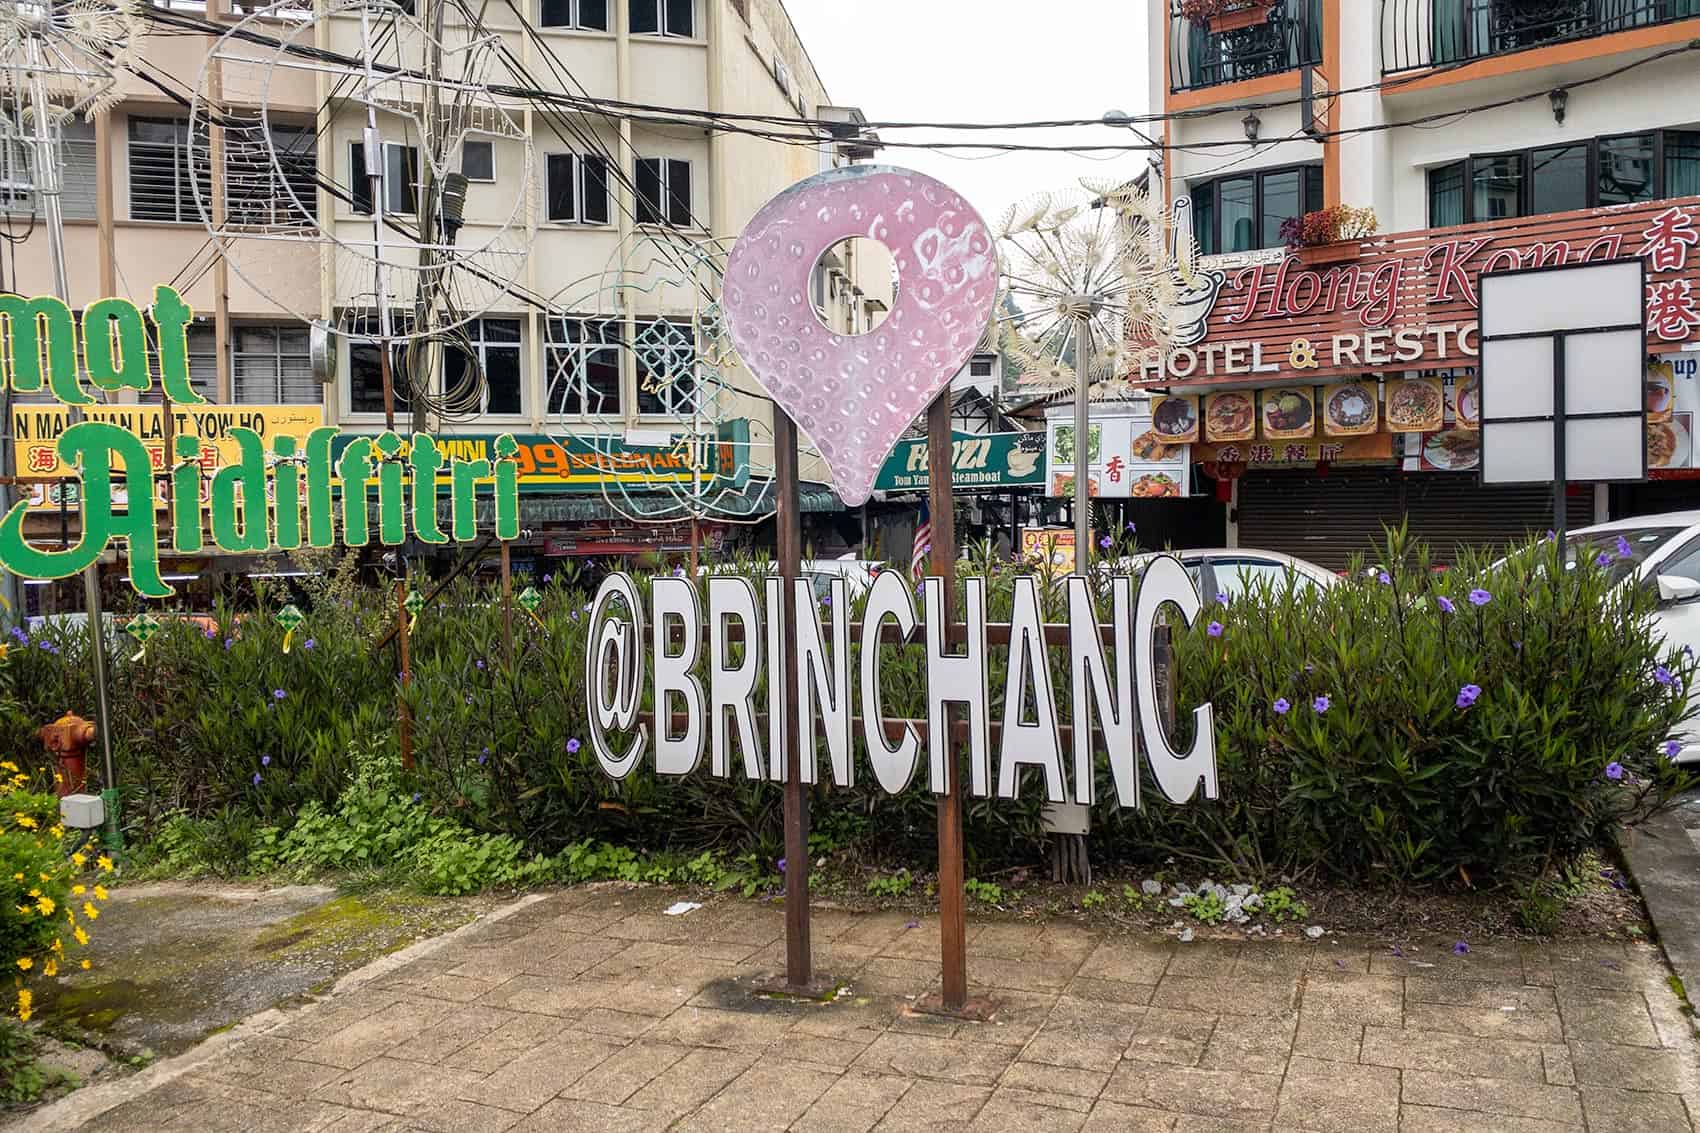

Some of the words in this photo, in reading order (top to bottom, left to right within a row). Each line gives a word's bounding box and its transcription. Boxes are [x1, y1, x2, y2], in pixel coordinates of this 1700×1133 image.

[1230, 253, 1404, 328] Hong
[1640, 206, 1700, 341] 香港
[1140, 341, 1281, 381] HOTEL
[1289, 337, 1319, 370] &
[193, 412, 233, 439] YOW
[437, 439, 486, 462] MINI
[516, 440, 570, 478] 99
[571, 452, 691, 469] SPEEDMART
[1105, 455, 1126, 484] 香
[0, 421, 521, 598] Aidilfitri
[584, 554, 1222, 809] @BRINCHANG
